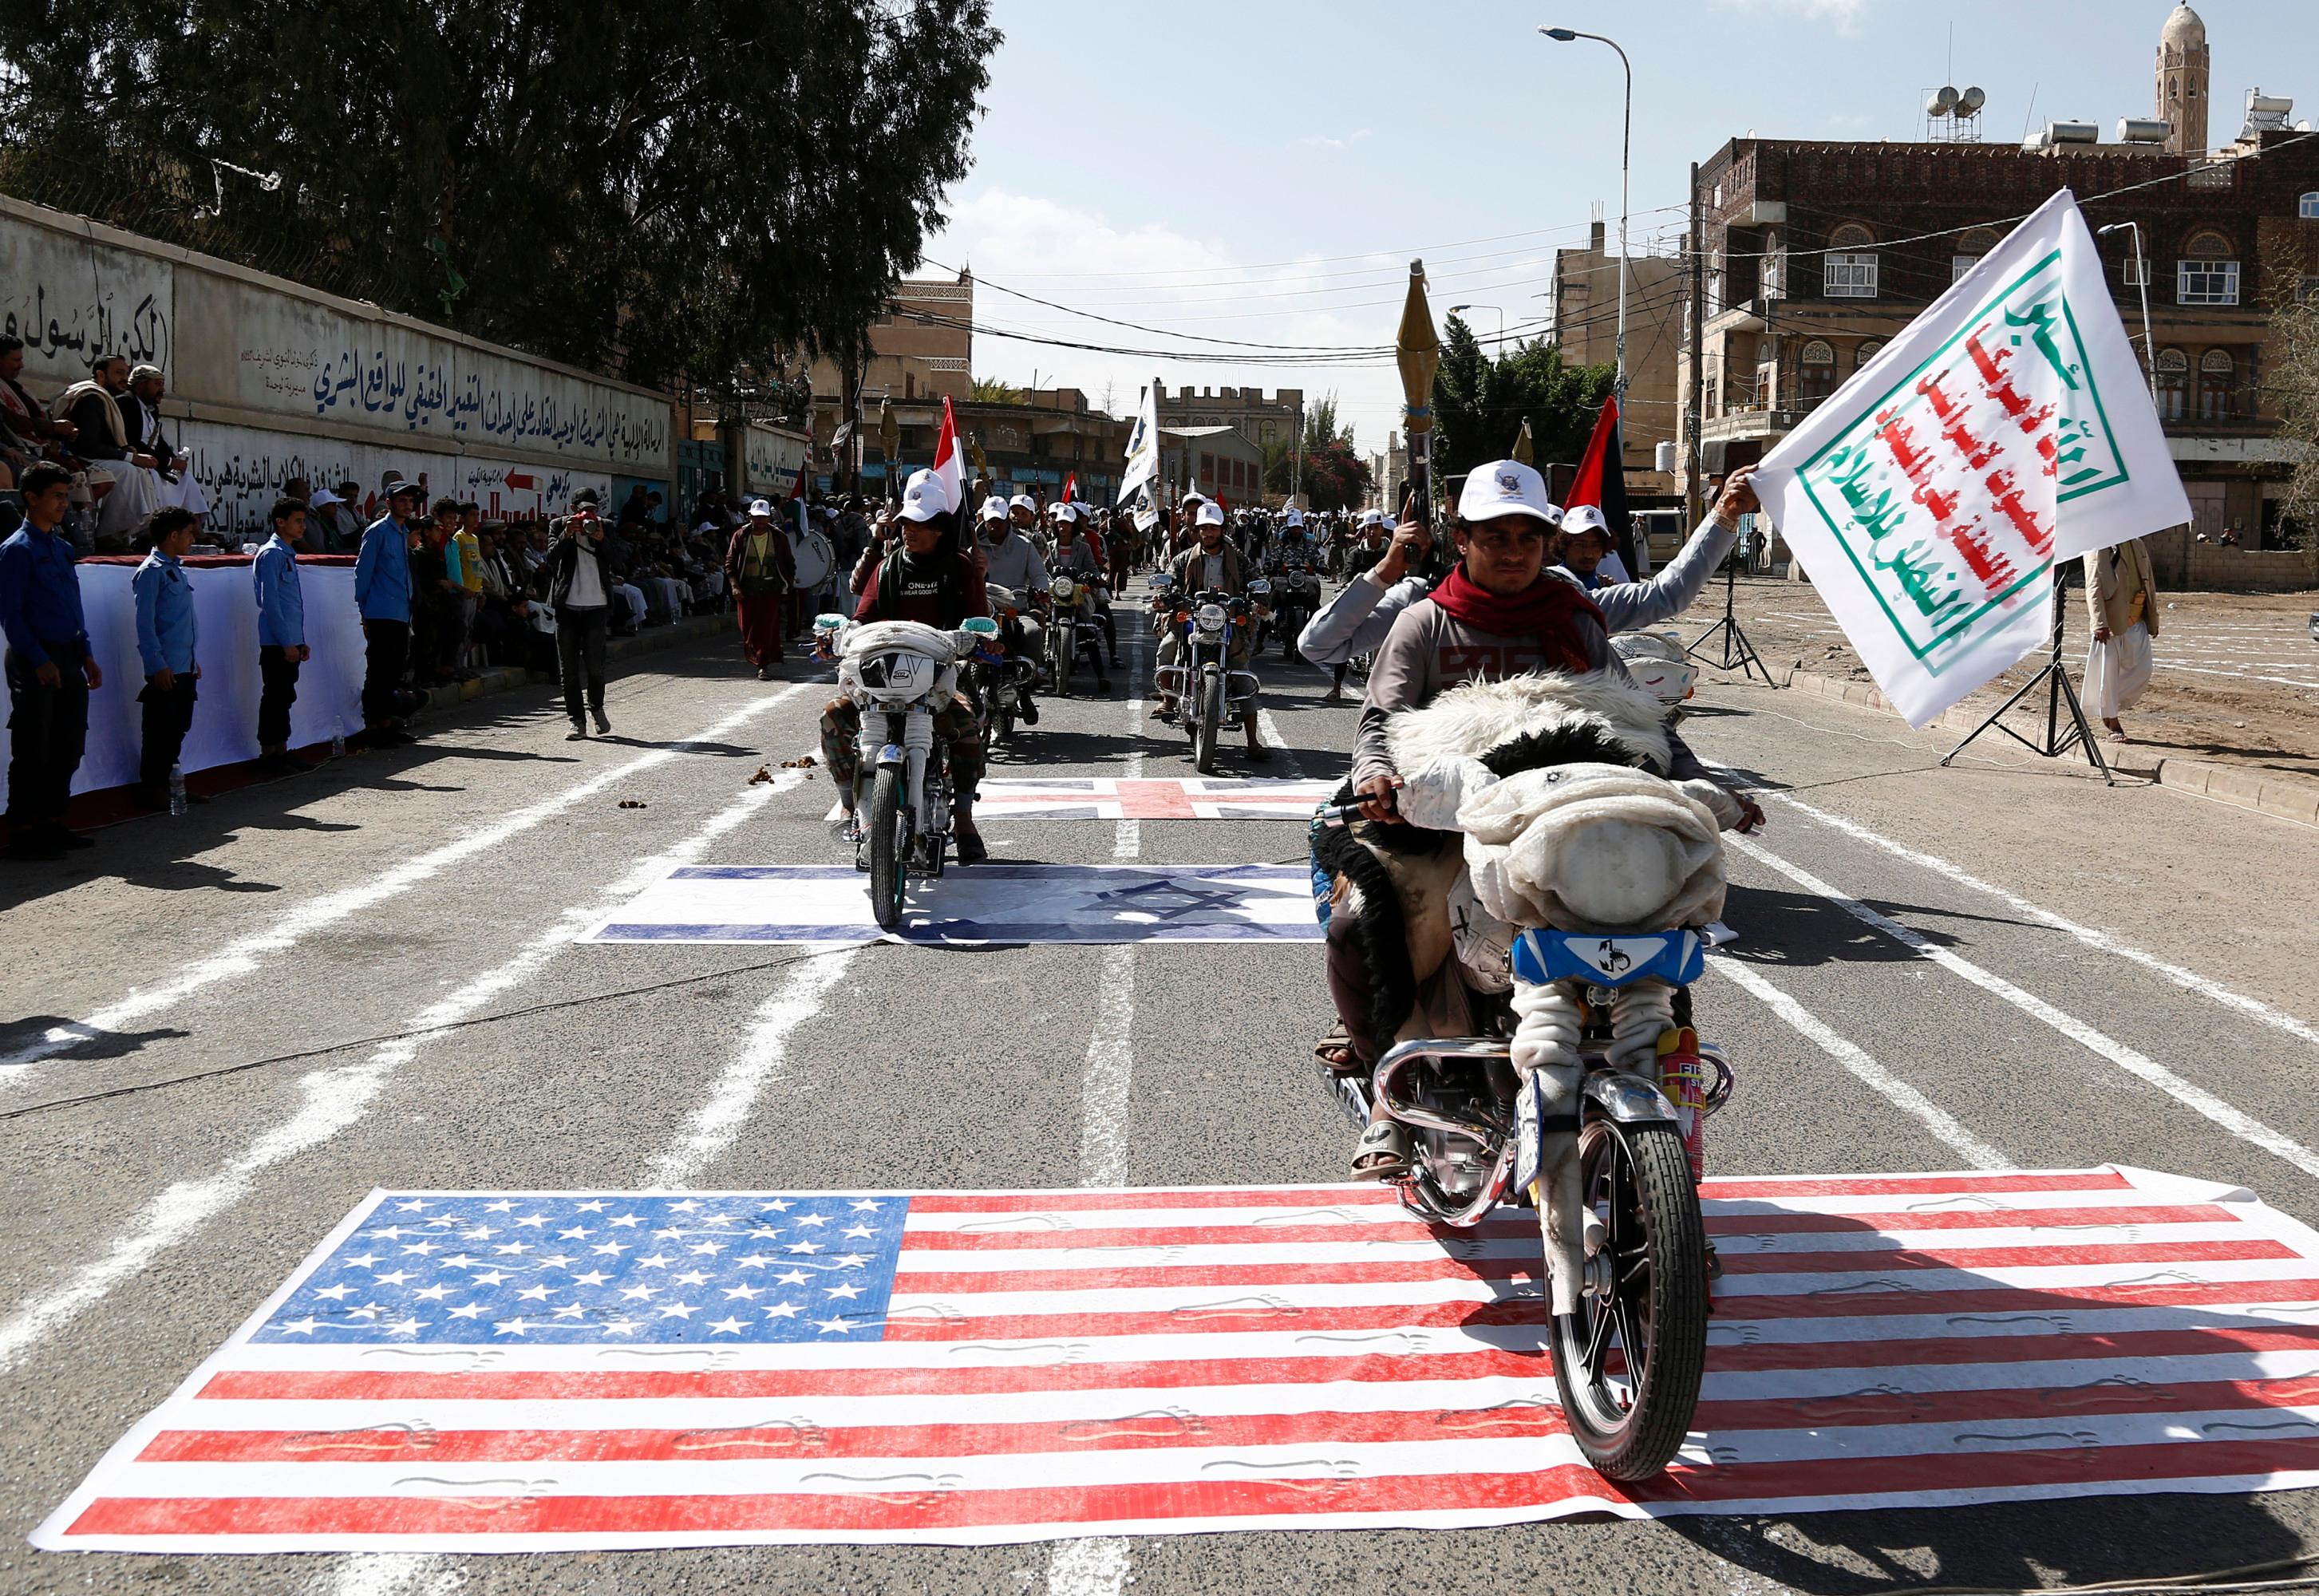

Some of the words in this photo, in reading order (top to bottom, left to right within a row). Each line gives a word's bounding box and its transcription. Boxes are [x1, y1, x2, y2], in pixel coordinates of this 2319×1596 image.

[2004, 302, 2080, 393] كبر
[314, 348, 364, 413] البشري
[365, 351, 405, 413] للواقع
[405, 365, 447, 429] الحقيقي
